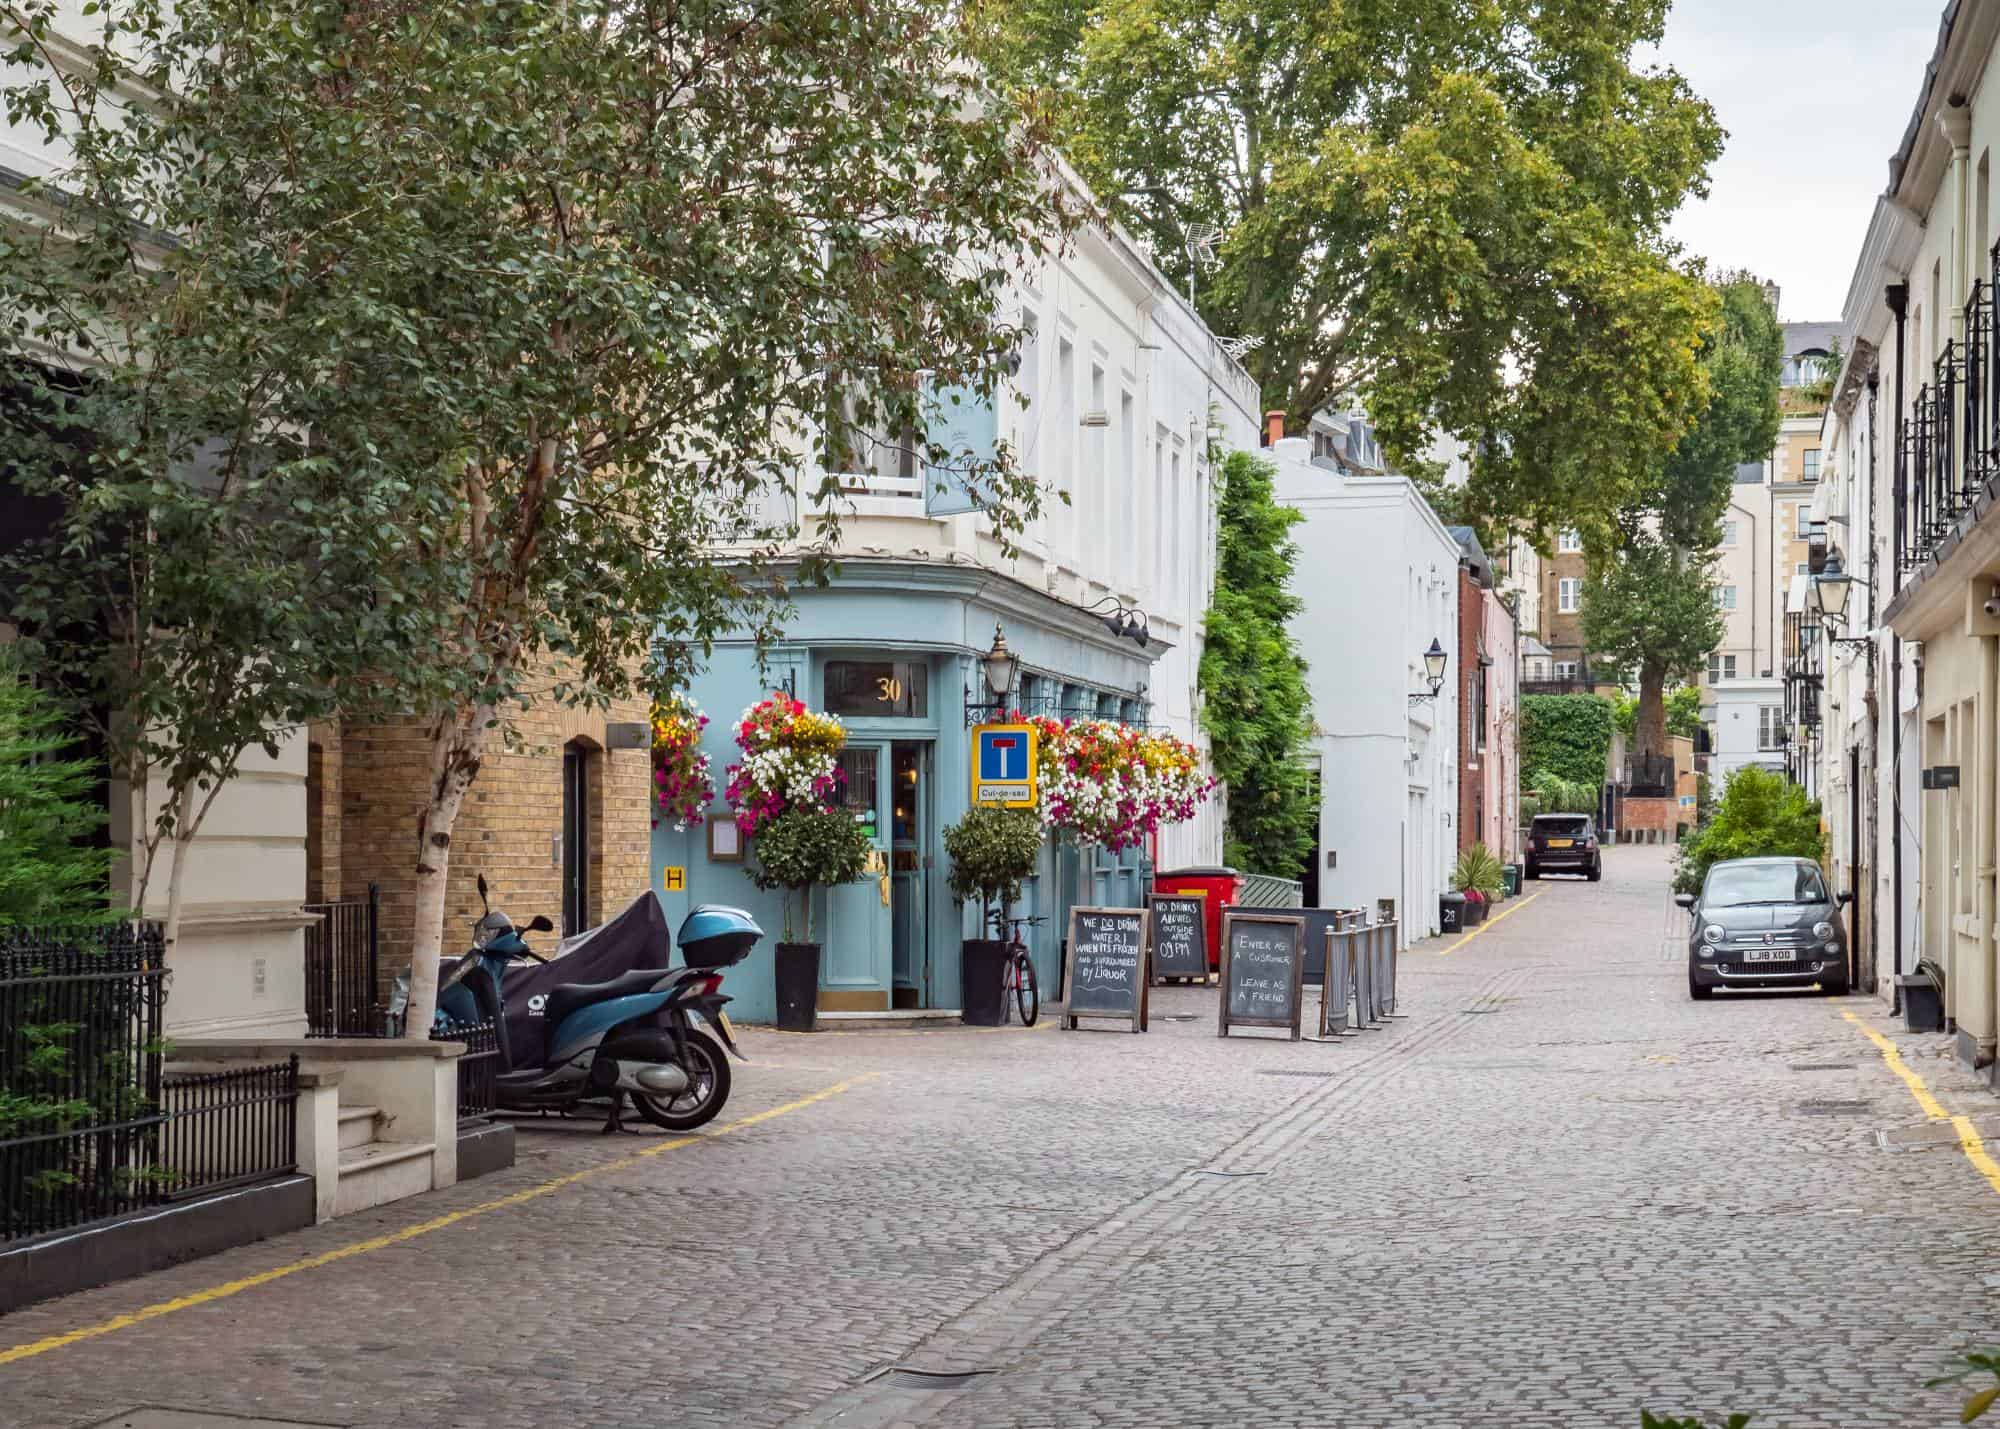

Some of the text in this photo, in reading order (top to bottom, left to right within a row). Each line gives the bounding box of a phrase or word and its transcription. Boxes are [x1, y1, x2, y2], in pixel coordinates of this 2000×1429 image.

[876, 677, 901, 702] 30
[982, 788, 1025, 798] Cul-de-sac
[667, 868, 682, 889] H
[1155, 902, 1197, 914] NO DRINKS
[1082, 917, 1097, 928] WE
[1101, 918, 1114, 930] DO
[1160, 913, 1192, 924] ALLOWED
[1162, 925, 1194, 936] OUTSIDE
[1075, 943, 1098, 953] WHEN
[1233, 951, 1241, 960] A
[1273, 980, 1285, 990] AS
[1239, 991, 1285, 1003] A FRIEND
